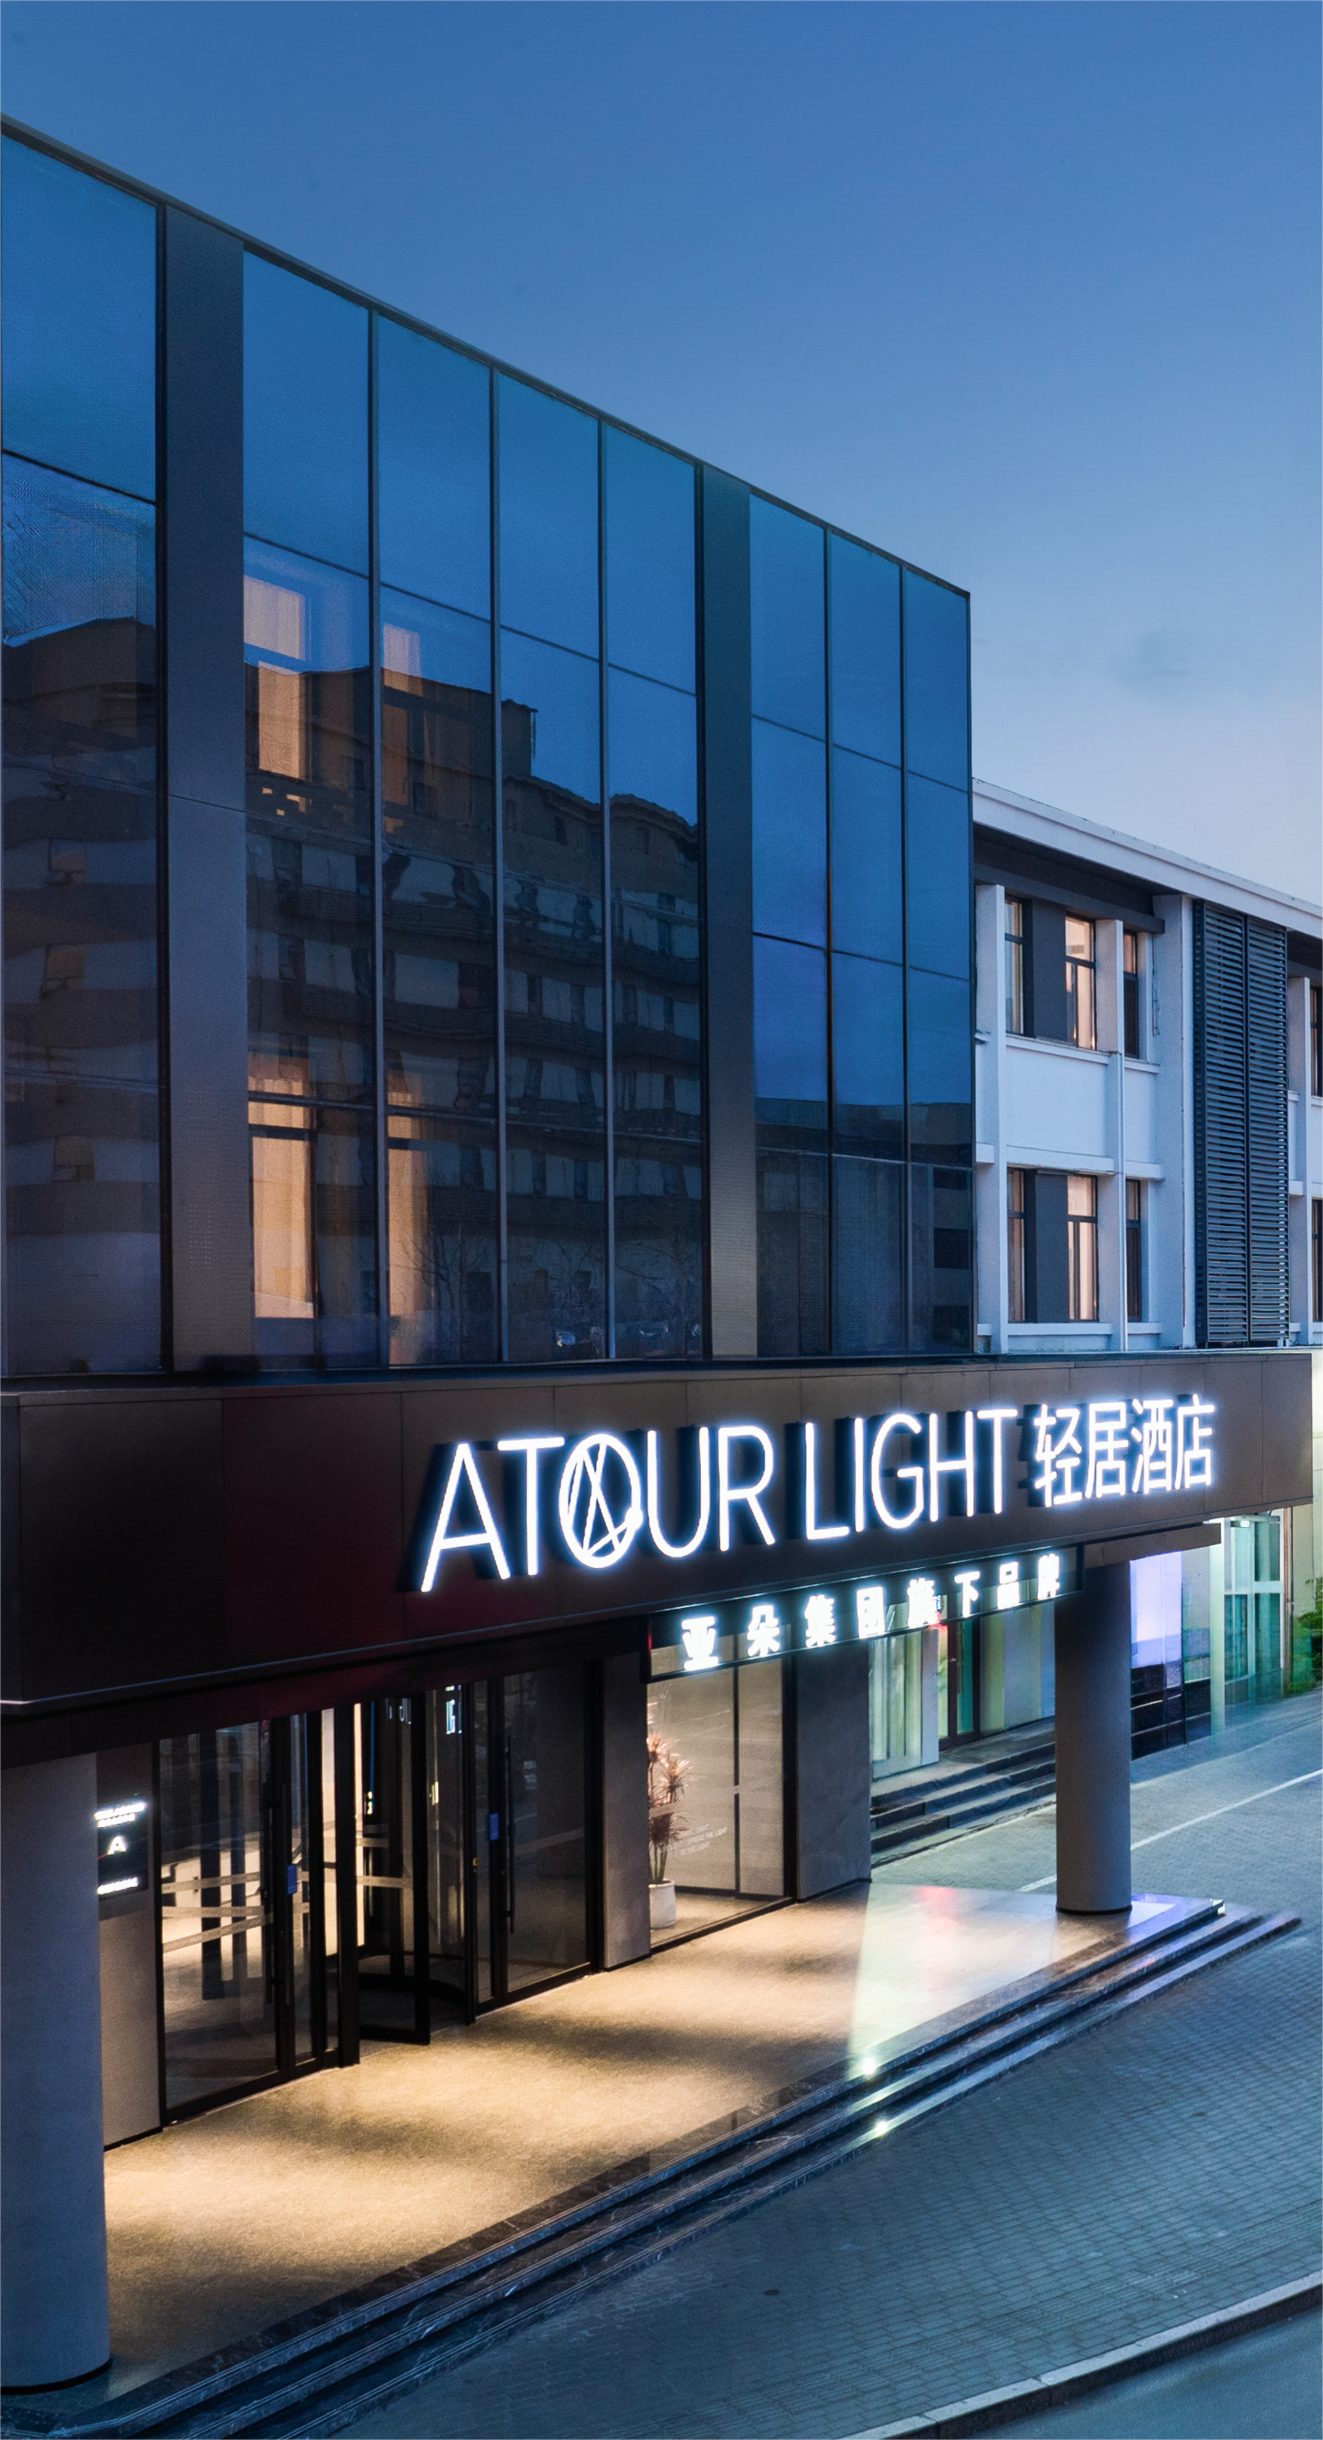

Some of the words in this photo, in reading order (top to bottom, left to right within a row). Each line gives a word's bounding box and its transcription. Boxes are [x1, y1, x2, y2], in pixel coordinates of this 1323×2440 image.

[421, 1425, 776, 1593] ATOUR
[804, 1407, 1018, 1541] LIGHT
[1033, 1393, 1215, 1508] 轻居酒店
